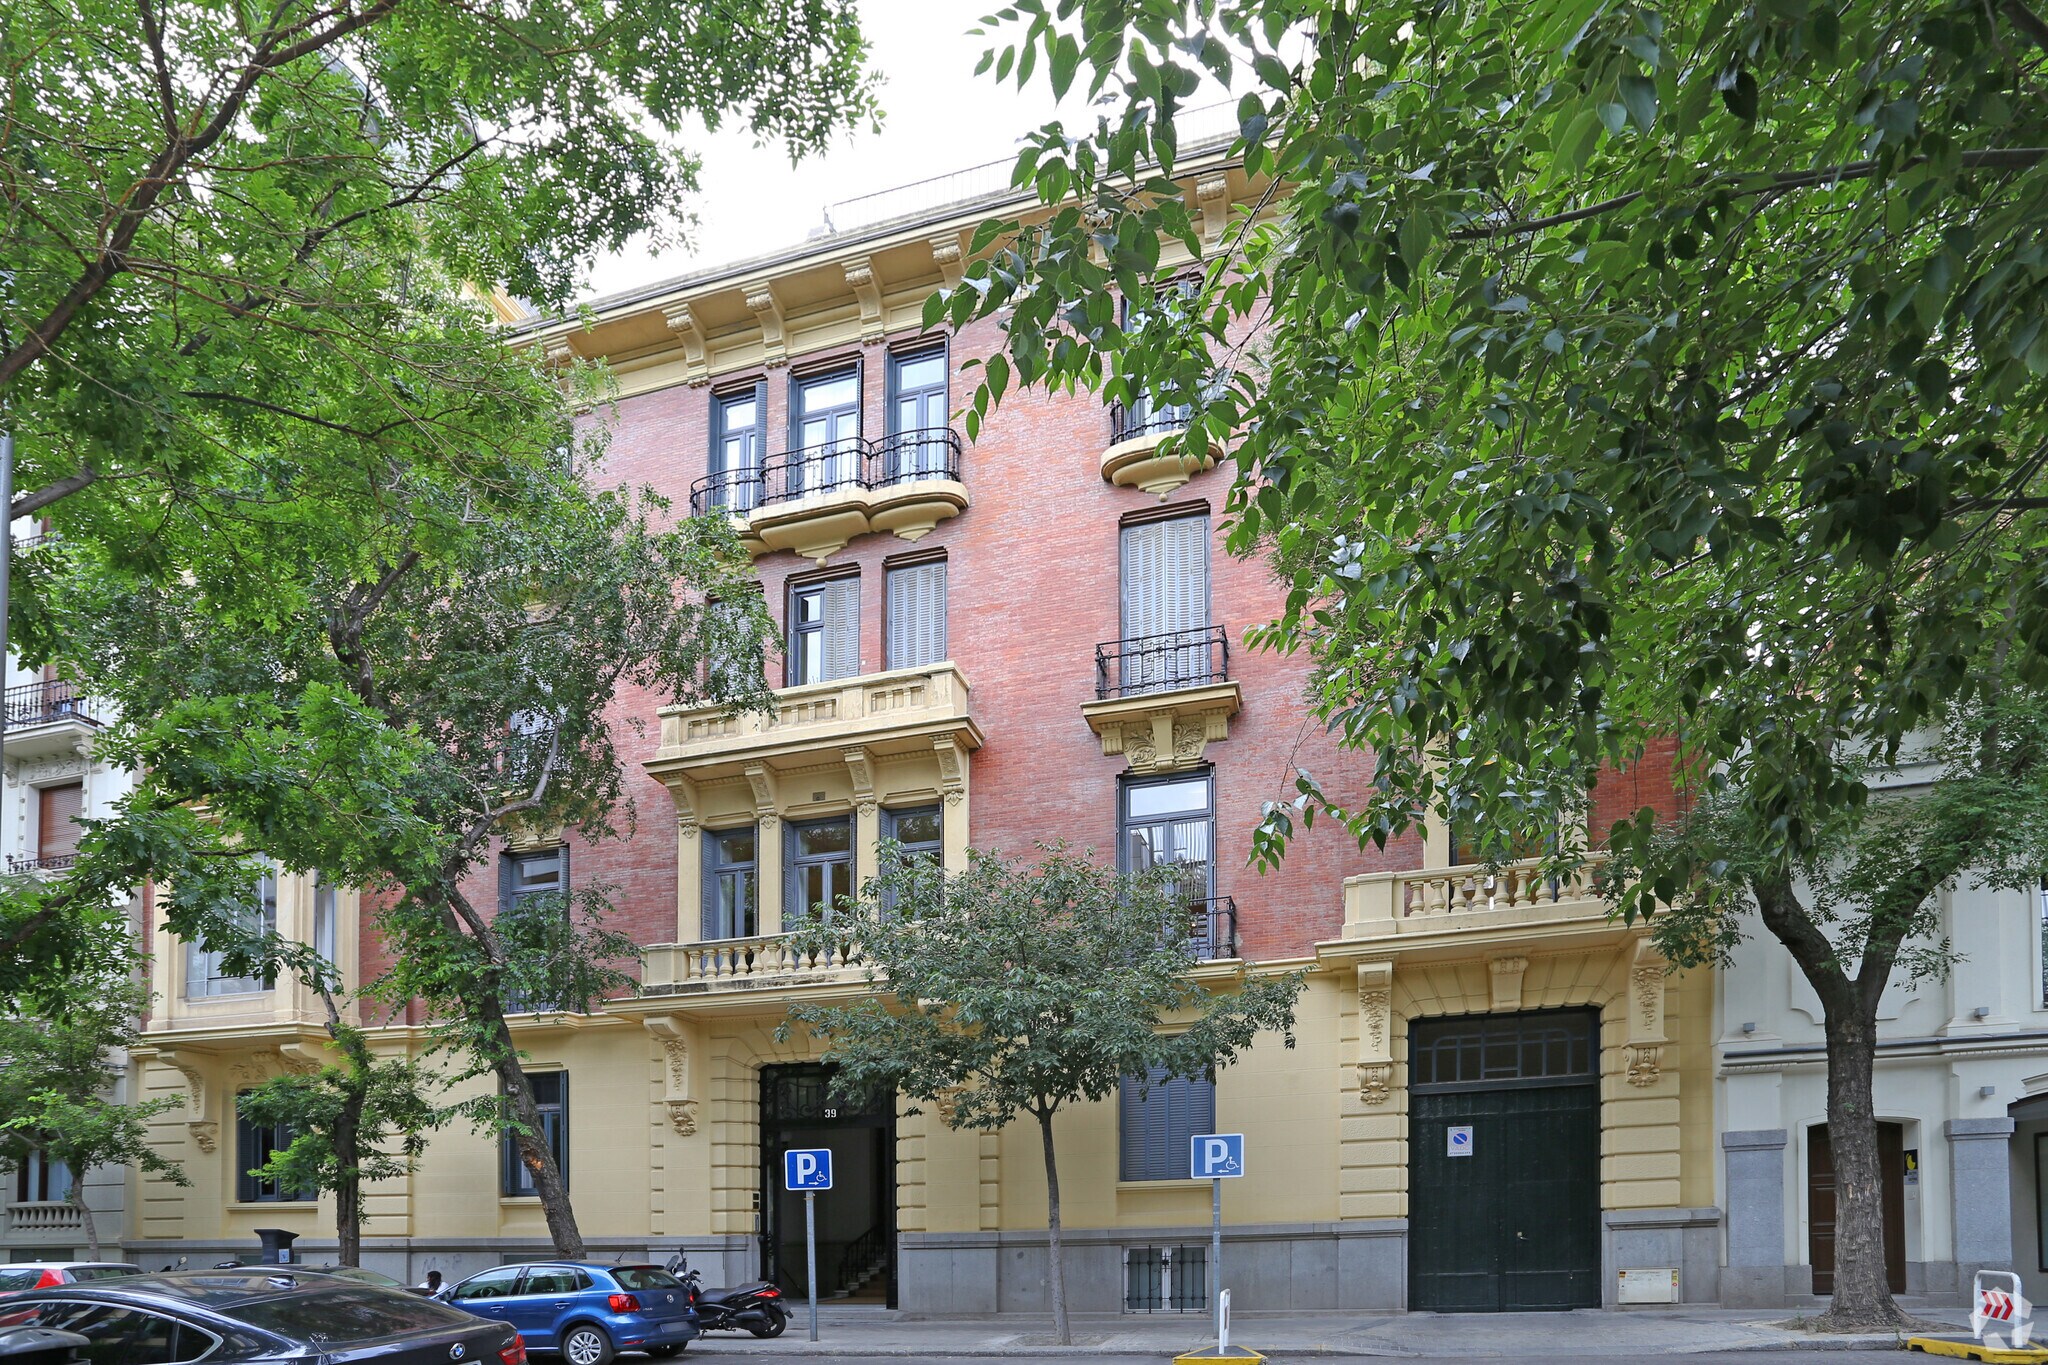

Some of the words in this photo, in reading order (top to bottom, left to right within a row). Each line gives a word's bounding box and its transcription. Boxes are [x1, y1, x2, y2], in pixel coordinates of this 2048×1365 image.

[824, 1108, 837, 1118] 39
[796, 1153, 817, 1185] P
[1205, 1139, 1228, 1174] P
